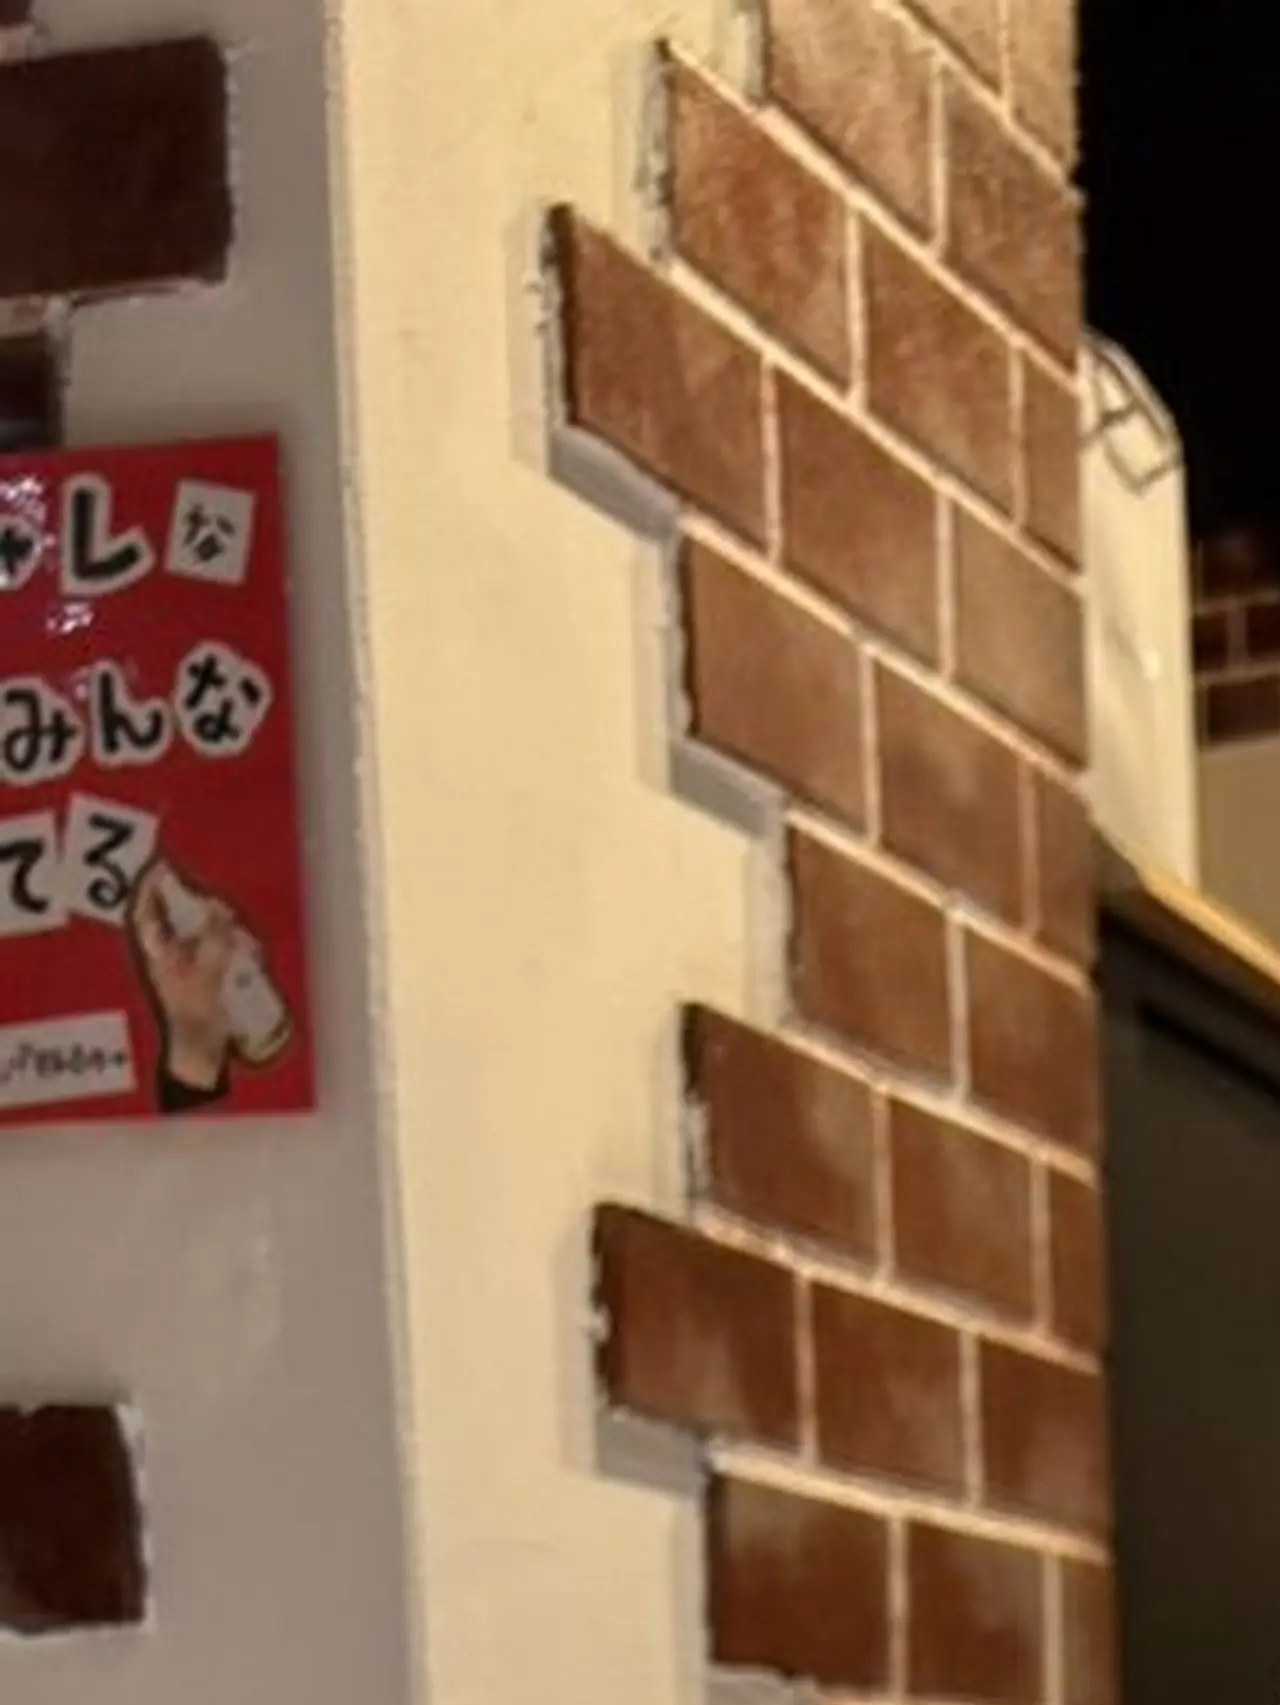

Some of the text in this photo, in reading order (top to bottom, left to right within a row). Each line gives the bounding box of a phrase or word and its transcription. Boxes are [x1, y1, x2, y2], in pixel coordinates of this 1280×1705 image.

[3, 653, 263, 773] みんな
[0, 812, 134, 914] てる
